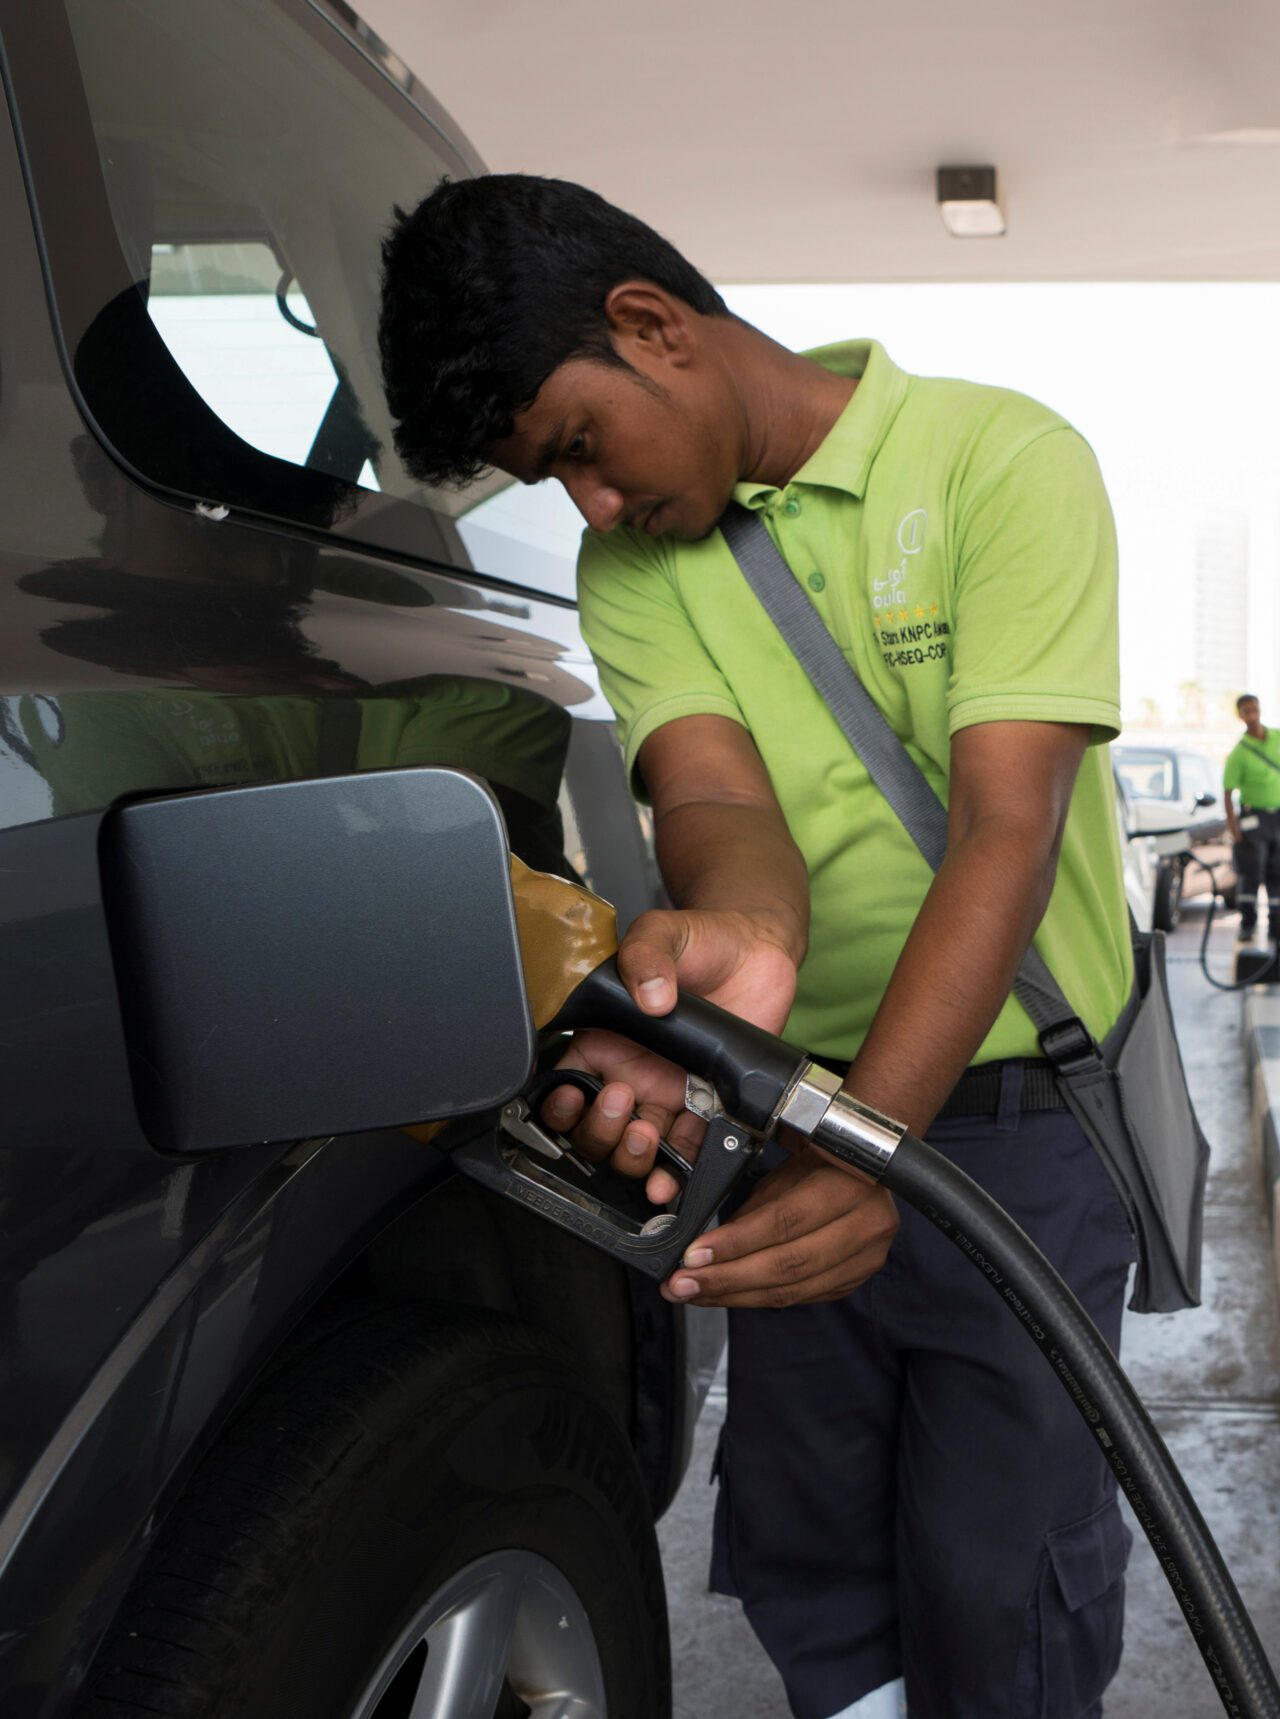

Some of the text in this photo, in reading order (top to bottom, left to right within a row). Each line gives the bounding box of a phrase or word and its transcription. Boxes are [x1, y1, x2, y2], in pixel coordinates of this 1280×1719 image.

[873, 585, 906, 608] oula
[899, 623, 933, 644] KNPC
[954, 1233, 1003, 1284] FLEXSTEEL
[1003, 1287, 1046, 1340] ContiTech
[1111, 1452, 1127, 1476] USA
[1131, 1494, 1156, 1528] MADE
